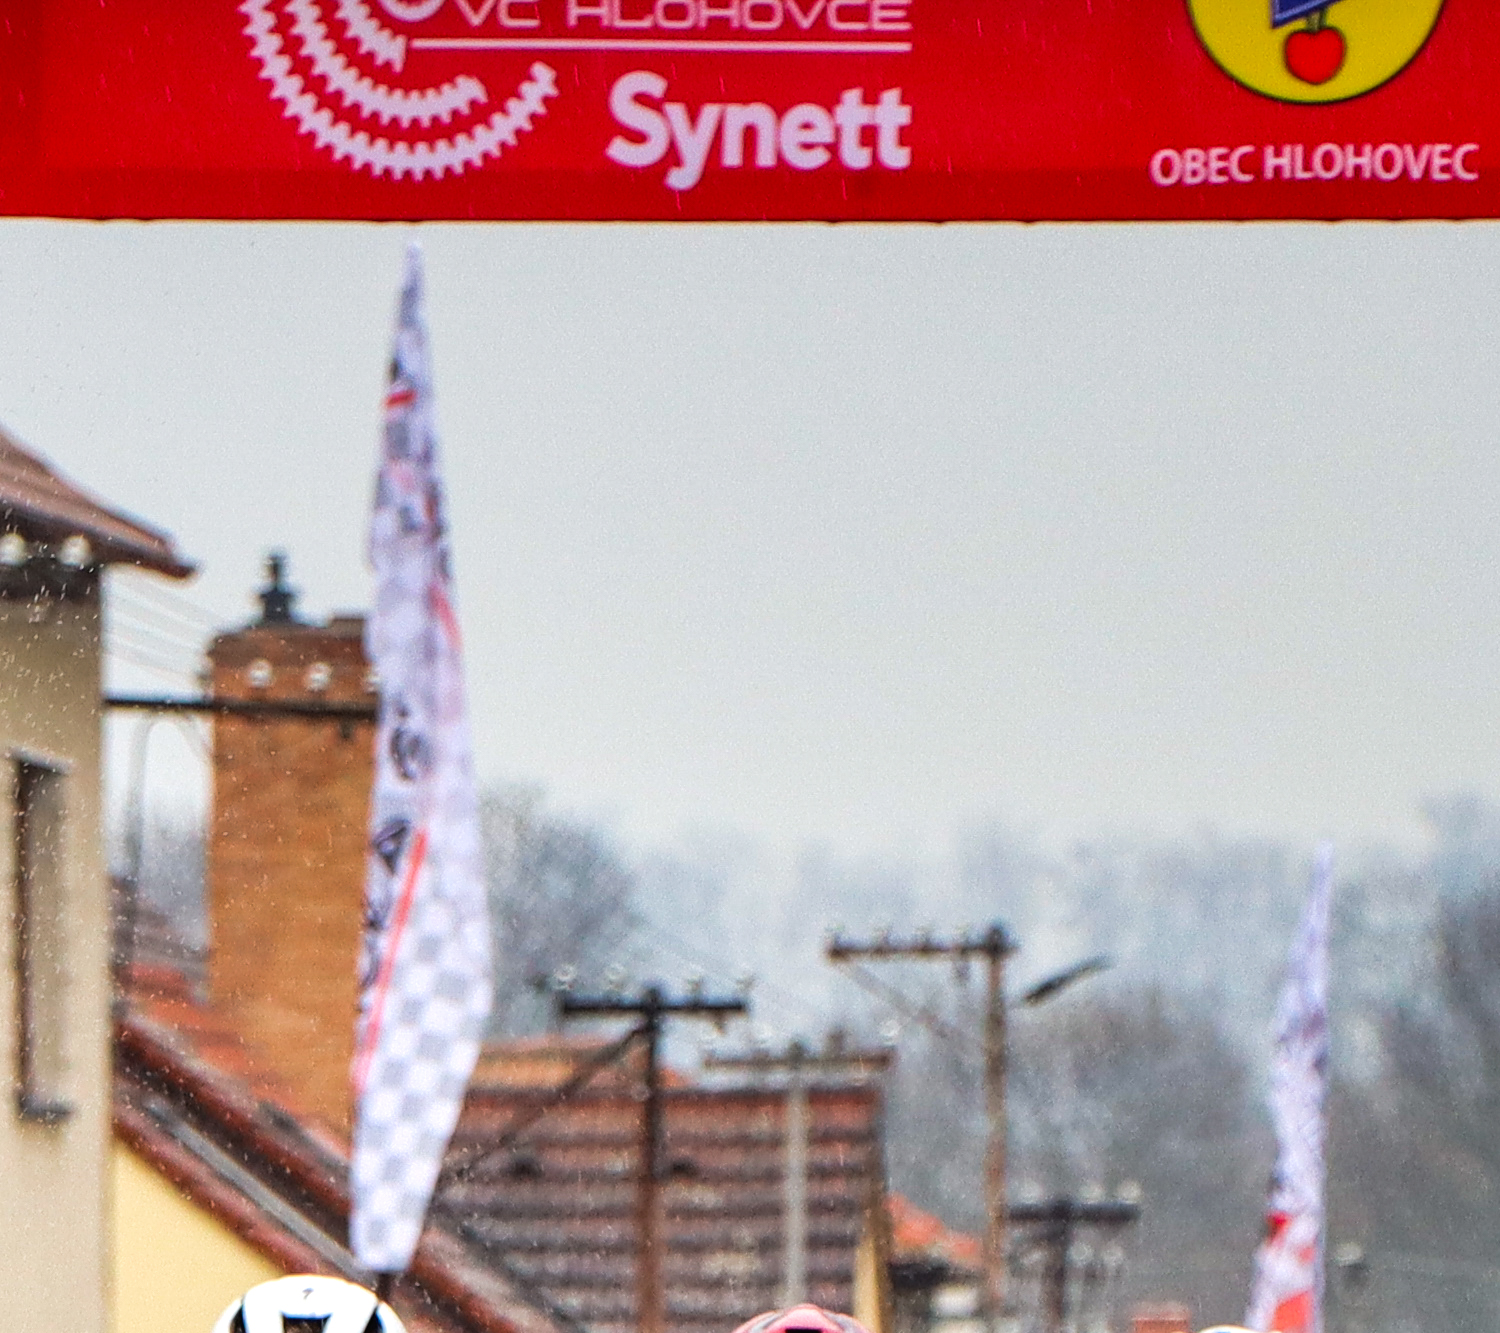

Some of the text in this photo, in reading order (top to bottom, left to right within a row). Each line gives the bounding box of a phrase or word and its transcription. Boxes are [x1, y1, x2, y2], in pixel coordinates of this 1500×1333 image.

[454, 0, 912, 31] VC HLOHOVCE
[606, 70, 913, 190] Synett
[1150, 143, 1479, 186] OBEC HLOHOVEC
